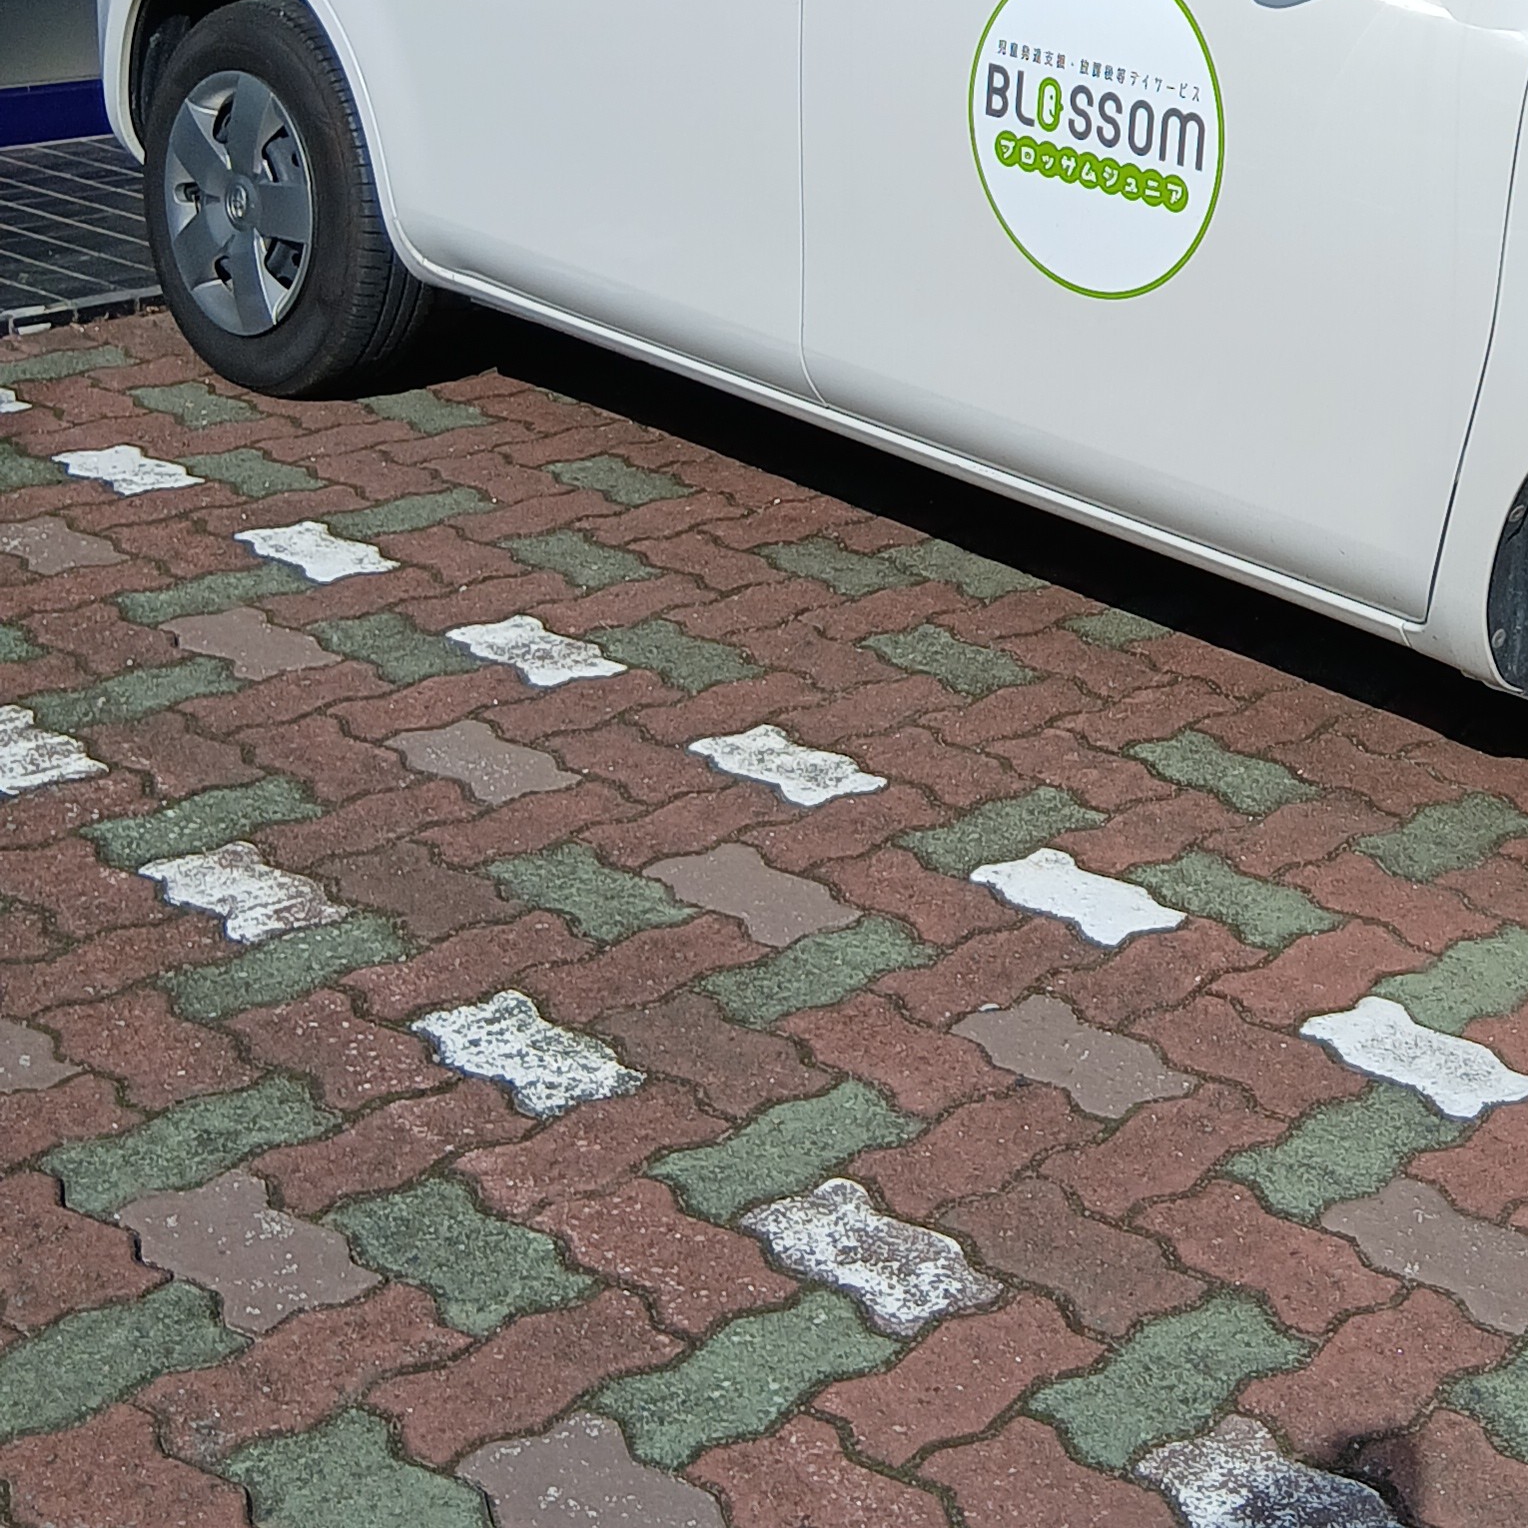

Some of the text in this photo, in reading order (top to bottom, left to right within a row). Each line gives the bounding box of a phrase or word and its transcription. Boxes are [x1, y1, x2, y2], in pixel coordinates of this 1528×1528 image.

[998, 138, 1185, 206] ブロッサムジュニア
